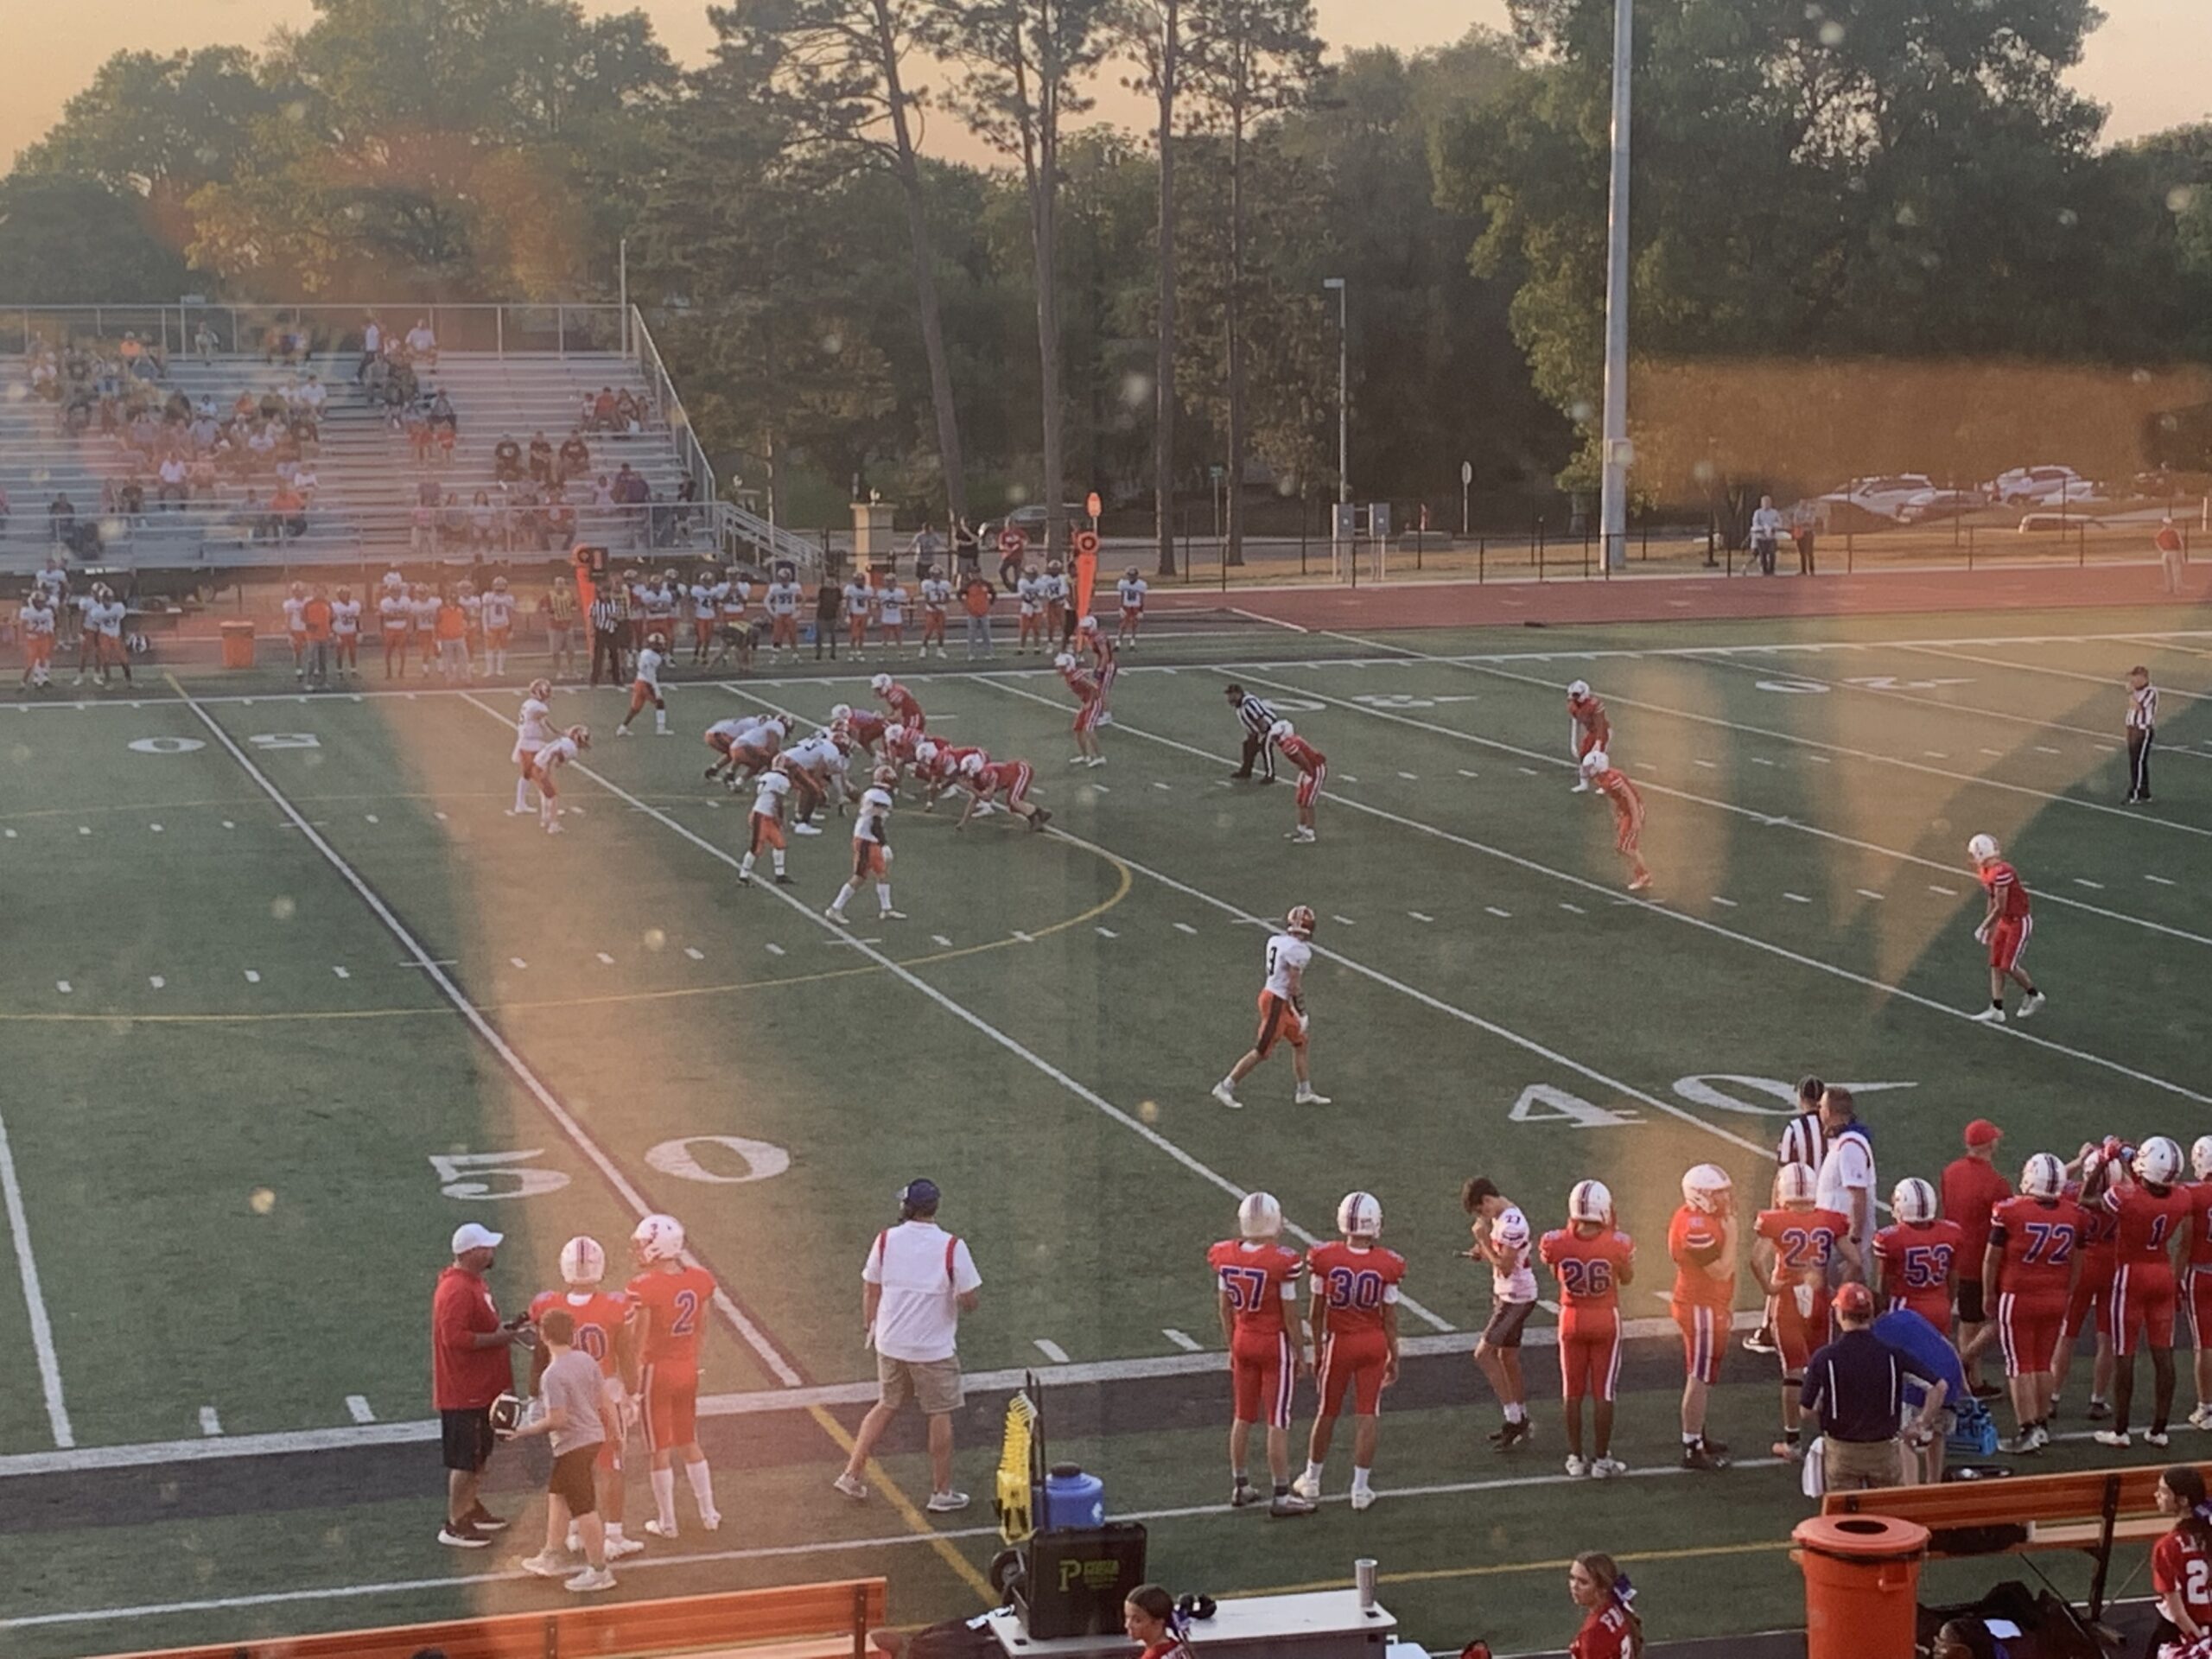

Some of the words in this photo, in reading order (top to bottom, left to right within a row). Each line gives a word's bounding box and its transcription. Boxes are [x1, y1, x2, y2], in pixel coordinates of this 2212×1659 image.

[1781, 1227, 1834, 1269] 23
[2023, 1222, 2076, 1266] 72
[2146, 1213, 2168, 1250] 1
[1558, 1257, 1612, 1296] 26
[1904, 1243, 1955, 1287] 53
[1219, 1265, 1268, 1313] 57
[1326, 1266, 1383, 1311] 30
[671, 1289, 699, 1337] 2
